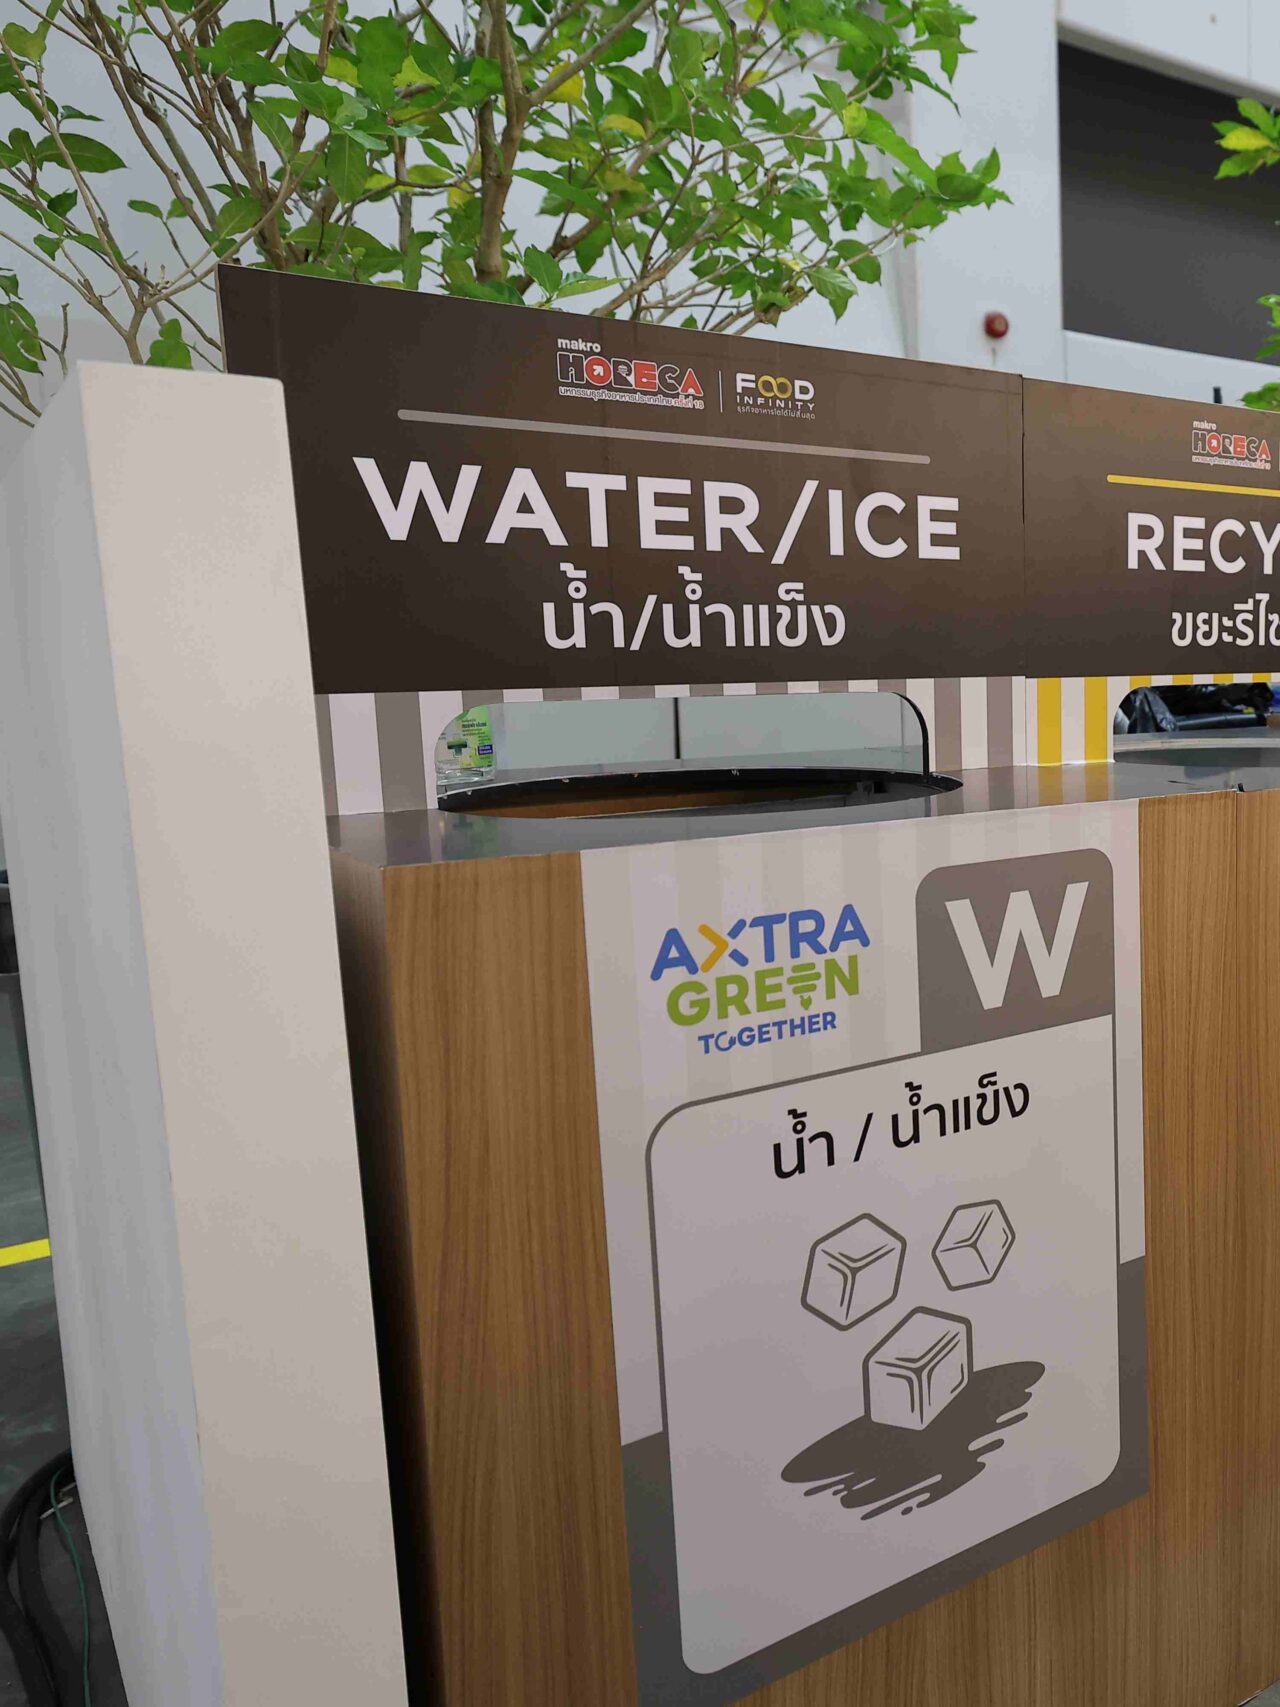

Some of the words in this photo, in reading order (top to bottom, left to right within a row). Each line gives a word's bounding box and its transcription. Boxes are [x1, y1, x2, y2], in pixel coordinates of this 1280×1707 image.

[556, 351, 704, 396] HORECA
[557, 338, 602, 353] makro
[735, 372, 815, 401] FOOD
[736, 395, 815, 411] INFINITY
[1191, 429, 1272, 461] HORECA
[352, 456, 961, 565] WATER/ICE
[542, 561, 847, 652] น้ำ/น้ำแข็ง
[649, 903, 871, 982] AXTRA
[944, 881, 1090, 1011] W
[665, 954, 861, 1027] GREEN
[697, 1010, 837, 1055] TOGETHER
[771, 1107, 836, 1180] น้ำ
[852, 1112, 874, 1163] /
[890, 1070, 1032, 1149] น้ำแข็ง
